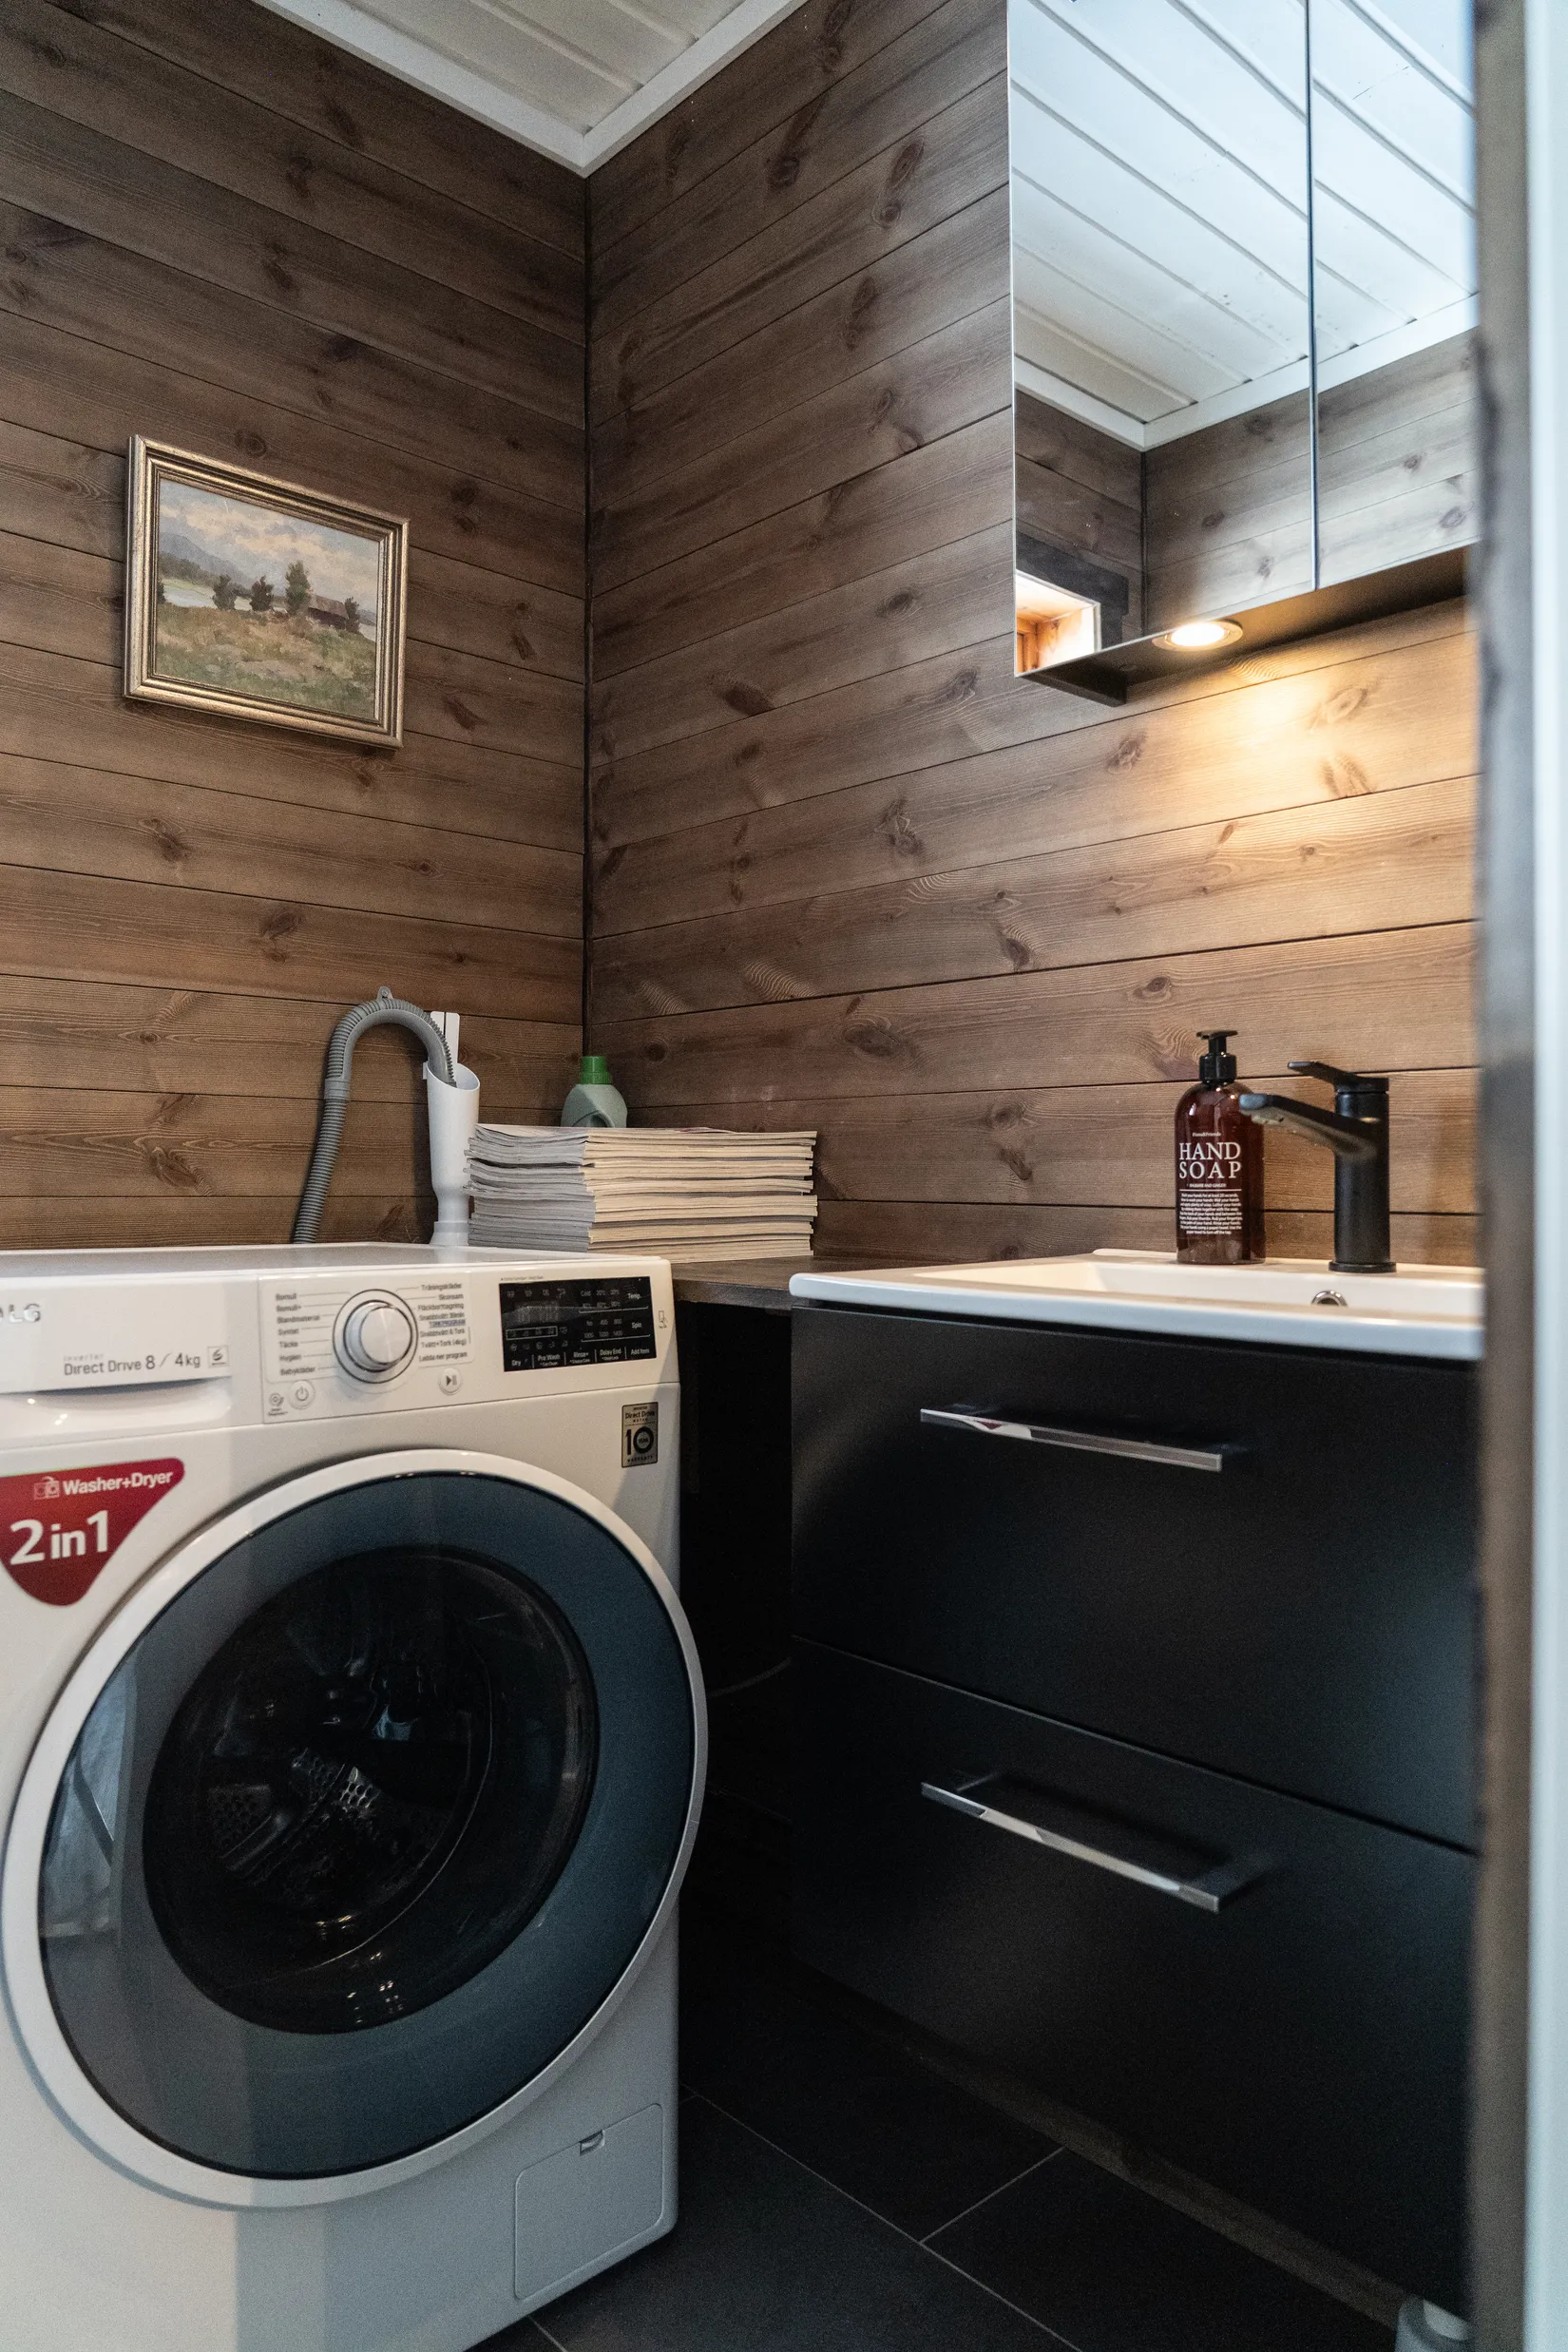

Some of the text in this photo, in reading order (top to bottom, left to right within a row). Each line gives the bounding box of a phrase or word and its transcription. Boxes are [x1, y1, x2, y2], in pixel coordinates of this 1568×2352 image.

[1179, 1142, 1241, 1160] HAND
[1179, 1161, 1241, 1179] SOAP
[9, 1303, 41, 1323] LG
[64, 1361, 105, 1376] Direct
[108, 1359, 142, 1373] Drive
[145, 1355, 156, 1370] 8
[175, 1352, 201, 1368] 4kg
[625, 1426, 654, 1455] 10
[63, 1472, 174, 1496] Washer+Dryer
